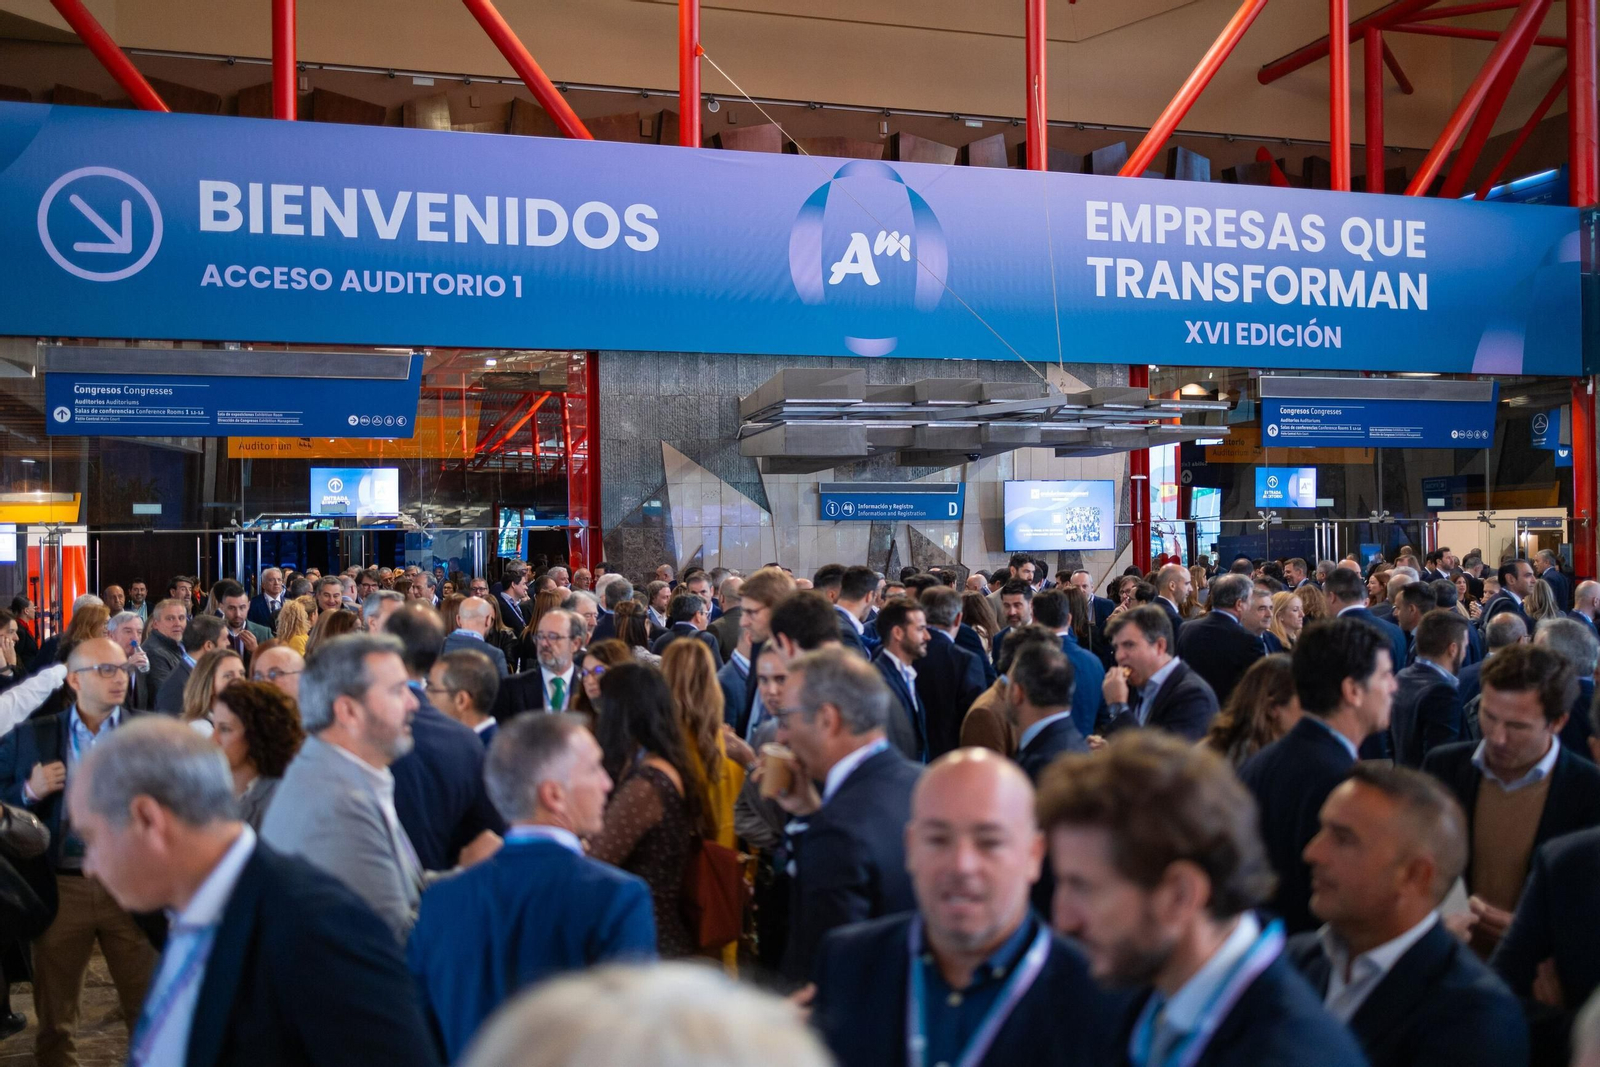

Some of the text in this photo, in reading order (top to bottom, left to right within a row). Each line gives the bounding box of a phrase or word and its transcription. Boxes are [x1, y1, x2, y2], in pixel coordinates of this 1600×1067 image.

[198, 179, 661, 252] BIENVENIDOS
[1085, 199, 1428, 261] EMPRESAS QUE
[200, 262, 524, 299] ACCESO AUDITORIO 1
[1085, 256, 1428, 312] TRANSFORMAN
[1184, 317, 1342, 349] XVI EDICIÓN
[73, 385, 173, 397] Congresos Congresses
[74, 398, 105, 406] Auditorios
[98, 407, 135, 415] conferencias
[1279, 407, 1342, 416] Congresos Congresses
[238, 441, 292, 451] Auditorium
[948, 502, 958, 516] D
